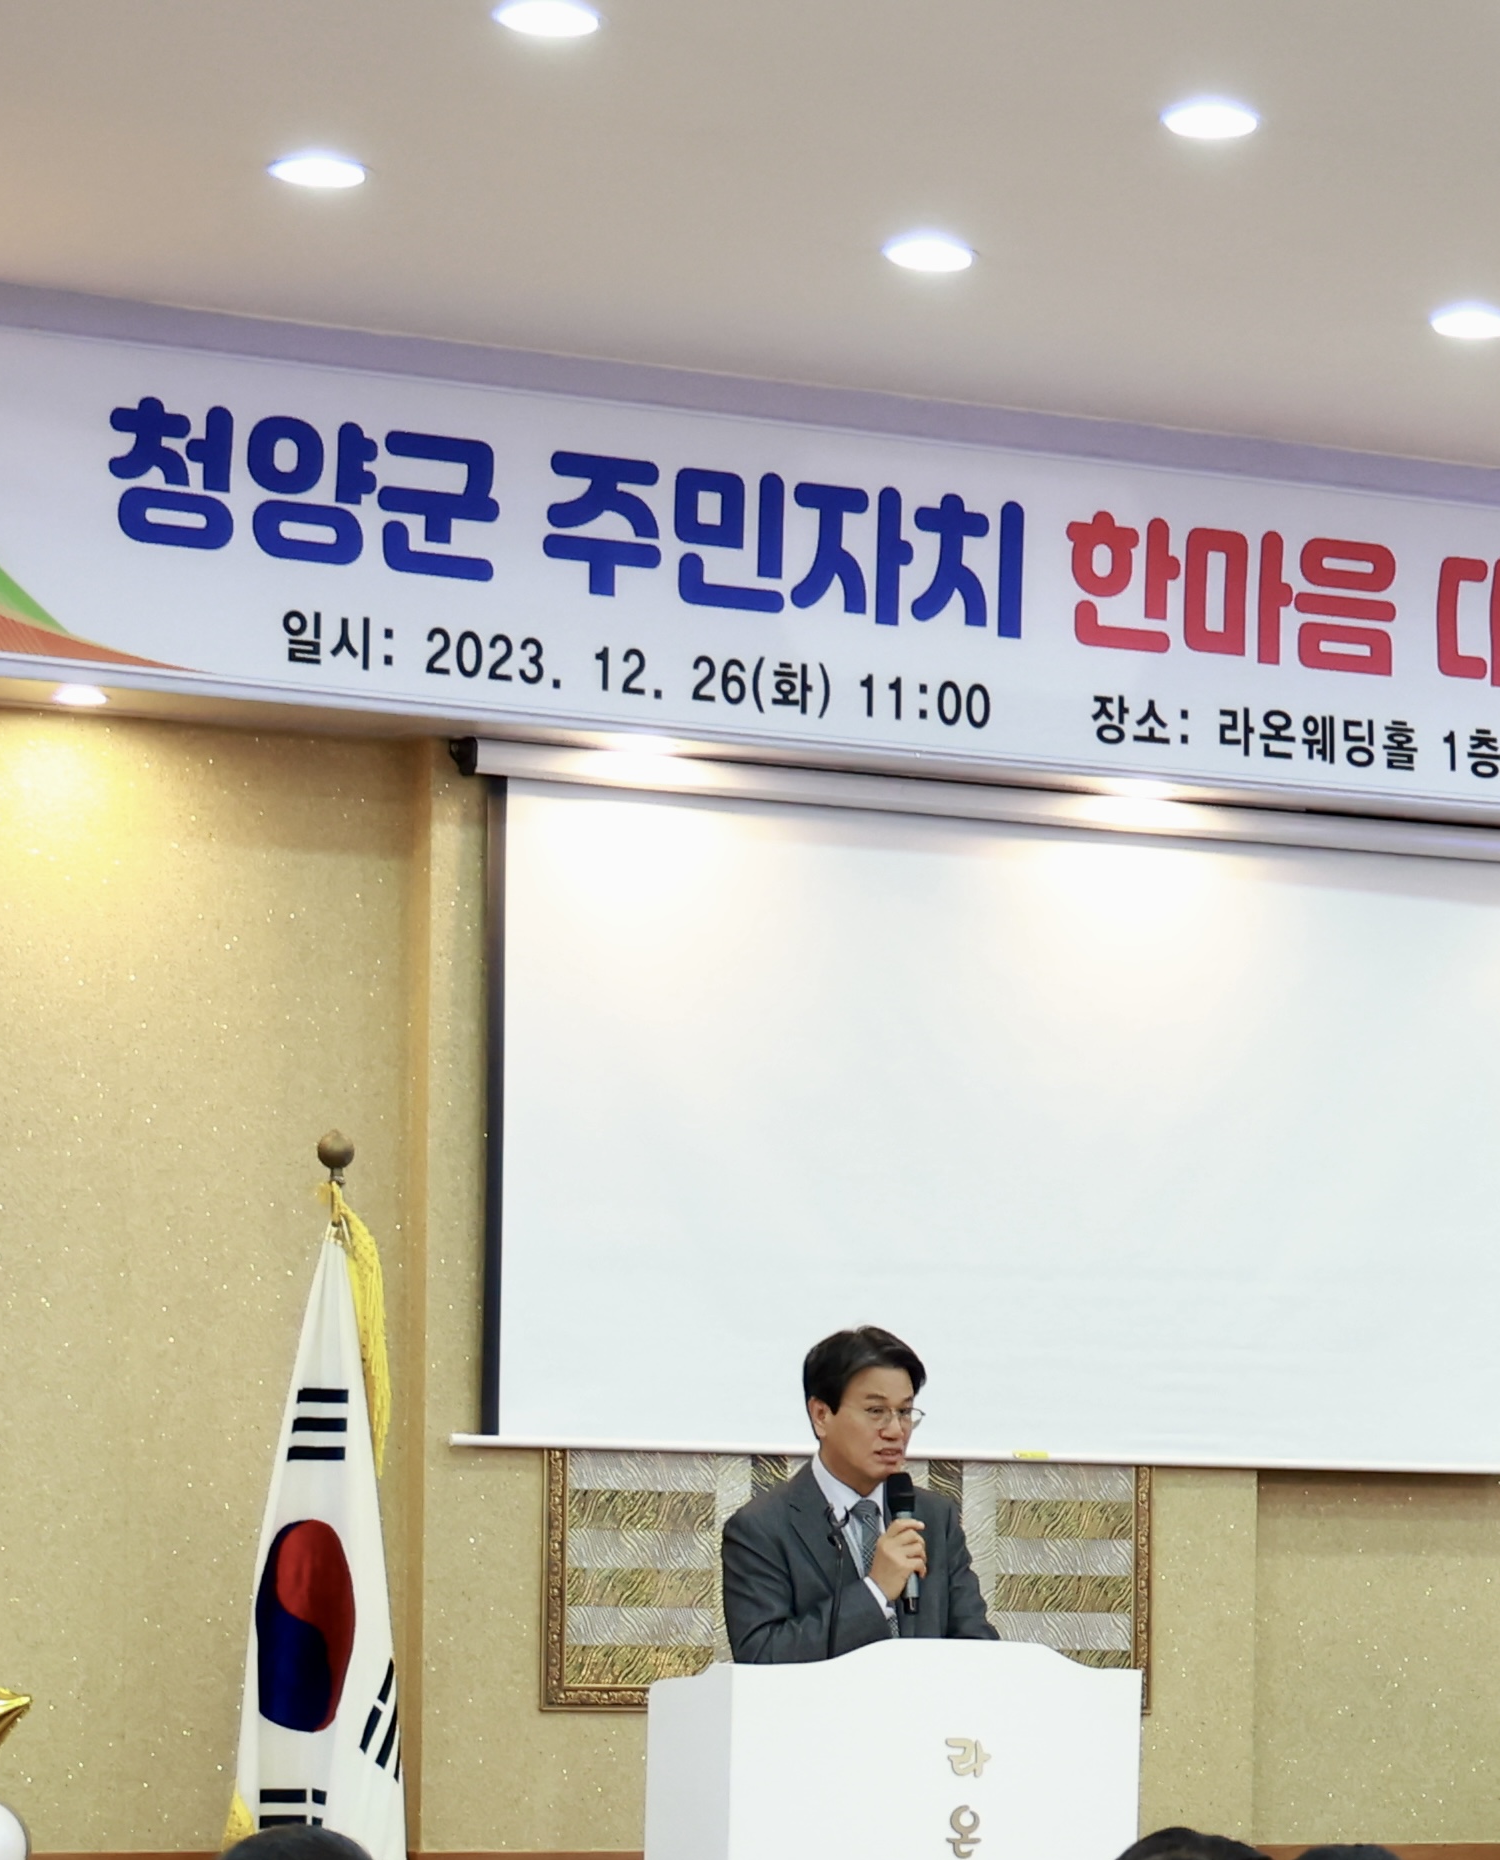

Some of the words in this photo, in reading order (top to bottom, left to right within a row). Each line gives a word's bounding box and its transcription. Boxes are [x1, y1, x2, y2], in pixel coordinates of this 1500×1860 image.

[107, 397, 500, 583] 청양군
[542, 451, 1025, 641] 주민자치
[1066, 509, 1398, 677] 한마음
[281, 609, 394, 672] 일시:
[424, 626, 562, 690] 2023.
[593, 645, 663, 701] 12.
[690, 654, 832, 720] 26(화)
[858, 672, 992, 730] 11:00
[1090, 693, 1190, 746] 장소:
[1218, 705, 1419, 772] 라온웨딩홀
